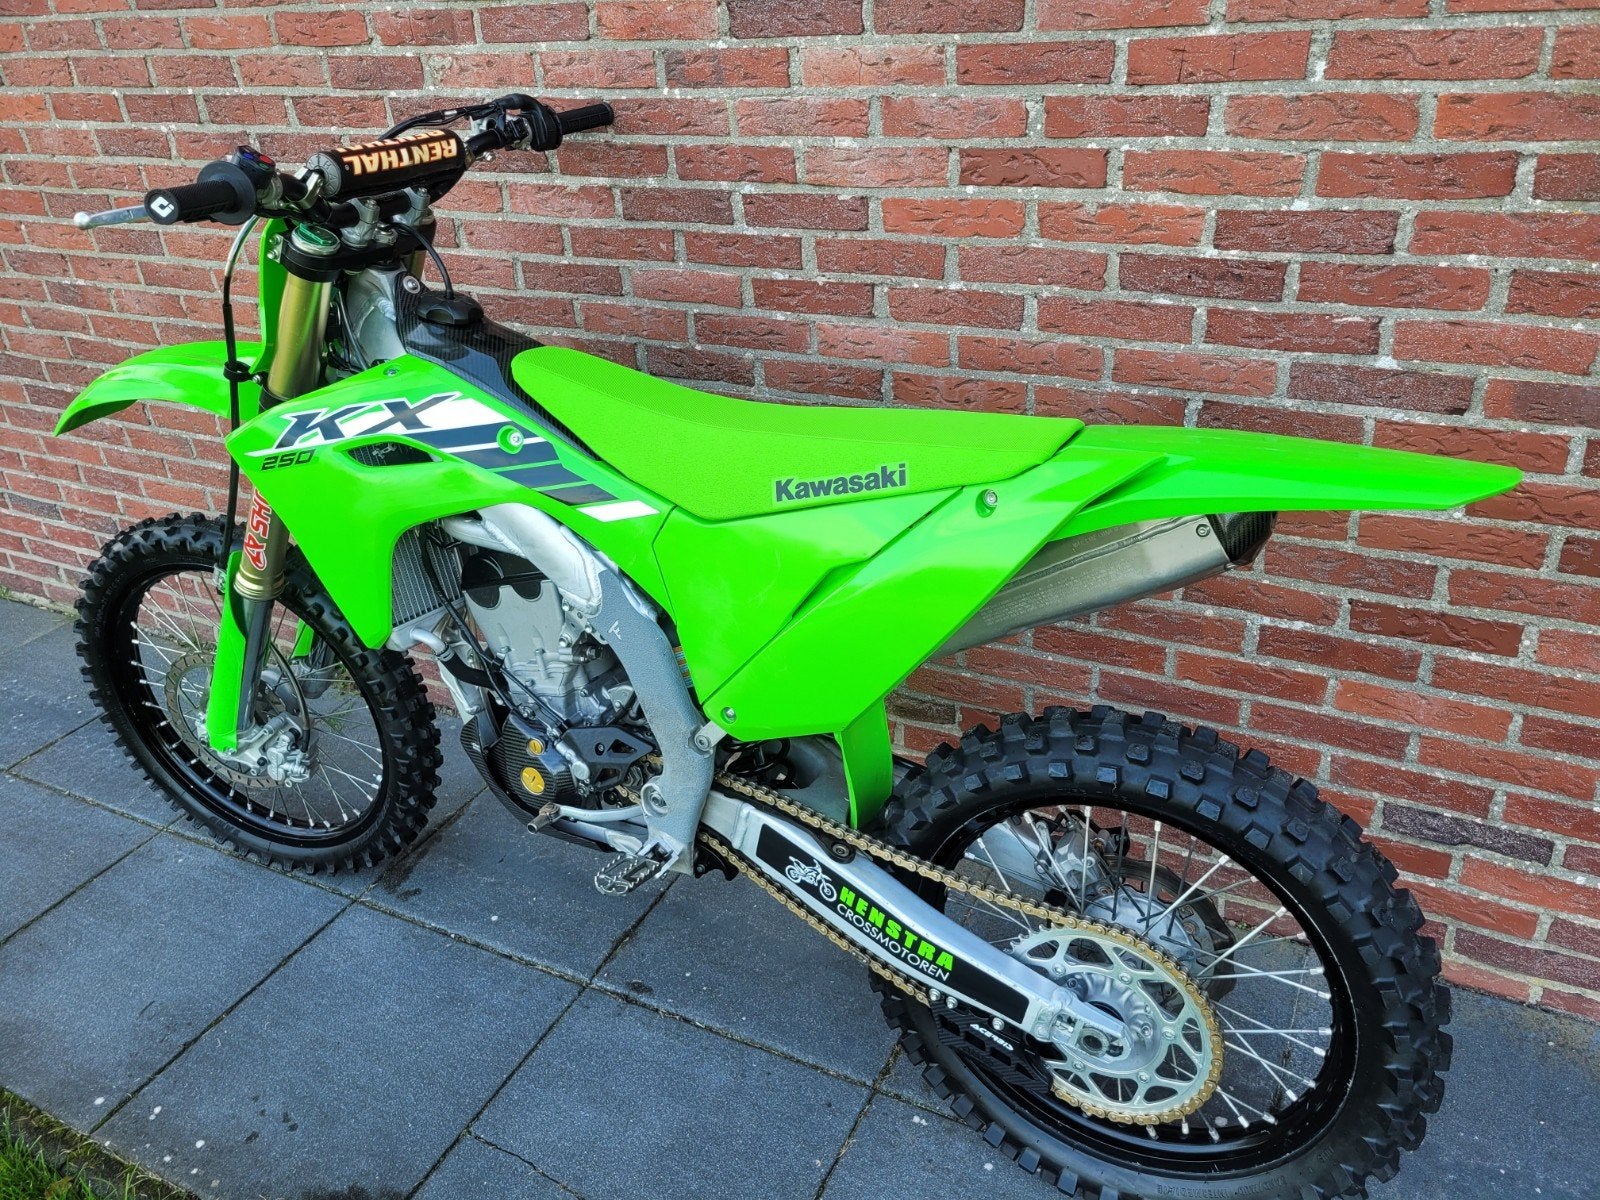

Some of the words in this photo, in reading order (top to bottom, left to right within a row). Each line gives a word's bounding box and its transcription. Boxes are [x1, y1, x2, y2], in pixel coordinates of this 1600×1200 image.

[342, 138, 457, 176] RENTHAL
[273, 391, 462, 450] KX
[261, 450, 316, 471] 250
[775, 462, 907, 503] Kawasaki
[836, 903, 950, 981] CROSSMOTOREN
[839, 885, 955, 971] HENSTRA
